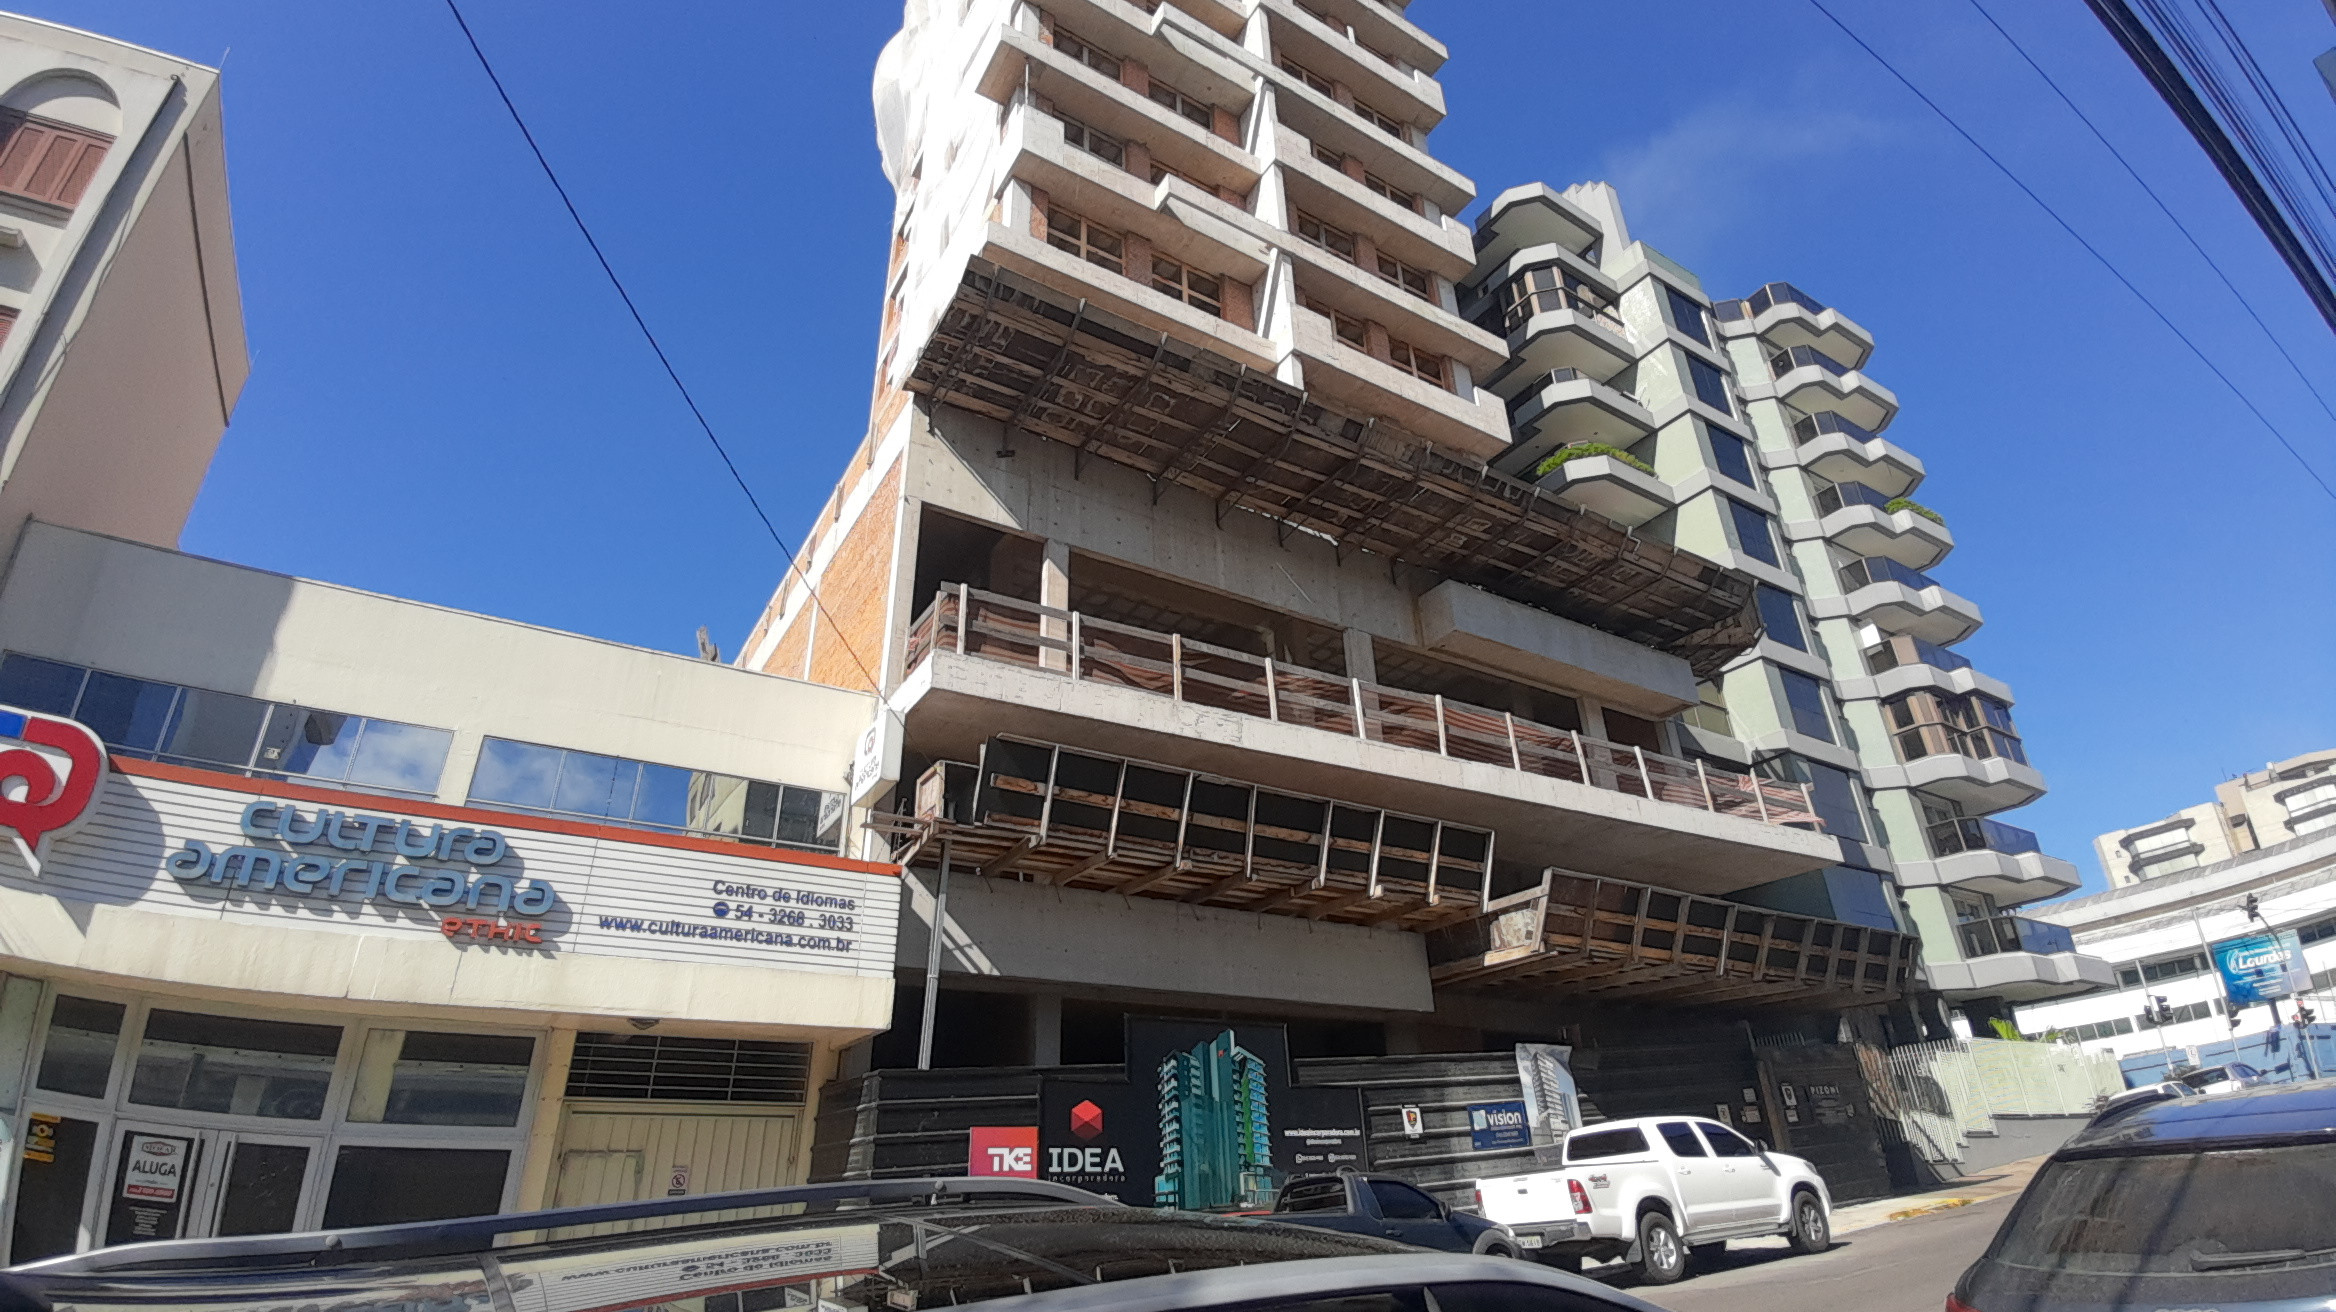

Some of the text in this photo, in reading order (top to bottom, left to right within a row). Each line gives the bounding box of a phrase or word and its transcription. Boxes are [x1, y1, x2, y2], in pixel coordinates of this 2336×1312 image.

[712, 879, 856, 911] Centro de Idiomas
[734, 903, 754, 921] 54
[818, 913, 854, 932] 3033
[598, 913, 852, 953] www.culturaamericana.com.br
[1487, 1109, 1522, 1126] vision
[132, 1159, 177, 1178] ALUGA
[987, 1147, 1032, 1172] TKE
[1048, 1147, 1125, 1173] IDEA
